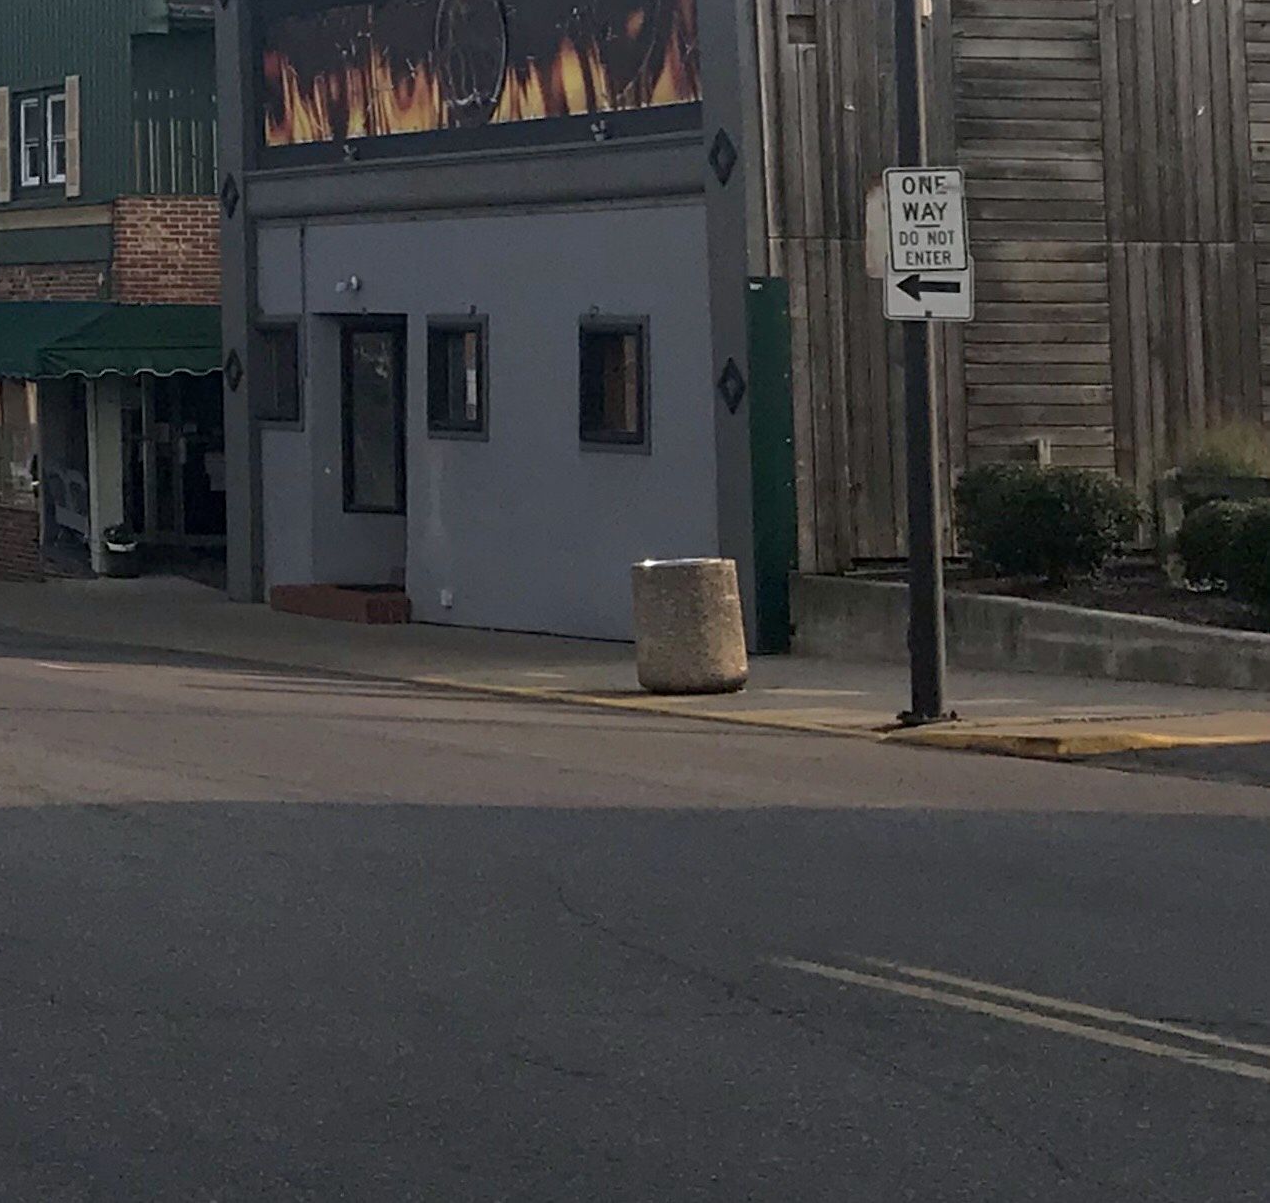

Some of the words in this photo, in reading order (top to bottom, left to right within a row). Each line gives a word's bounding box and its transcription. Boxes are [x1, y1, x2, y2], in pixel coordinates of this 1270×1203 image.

[902, 176, 947, 196] ONE
[902, 201, 948, 222] WAY
[899, 230, 919, 247] DO
[927, 229, 956, 246] NOT
[905, 250, 952, 266] ENTER
